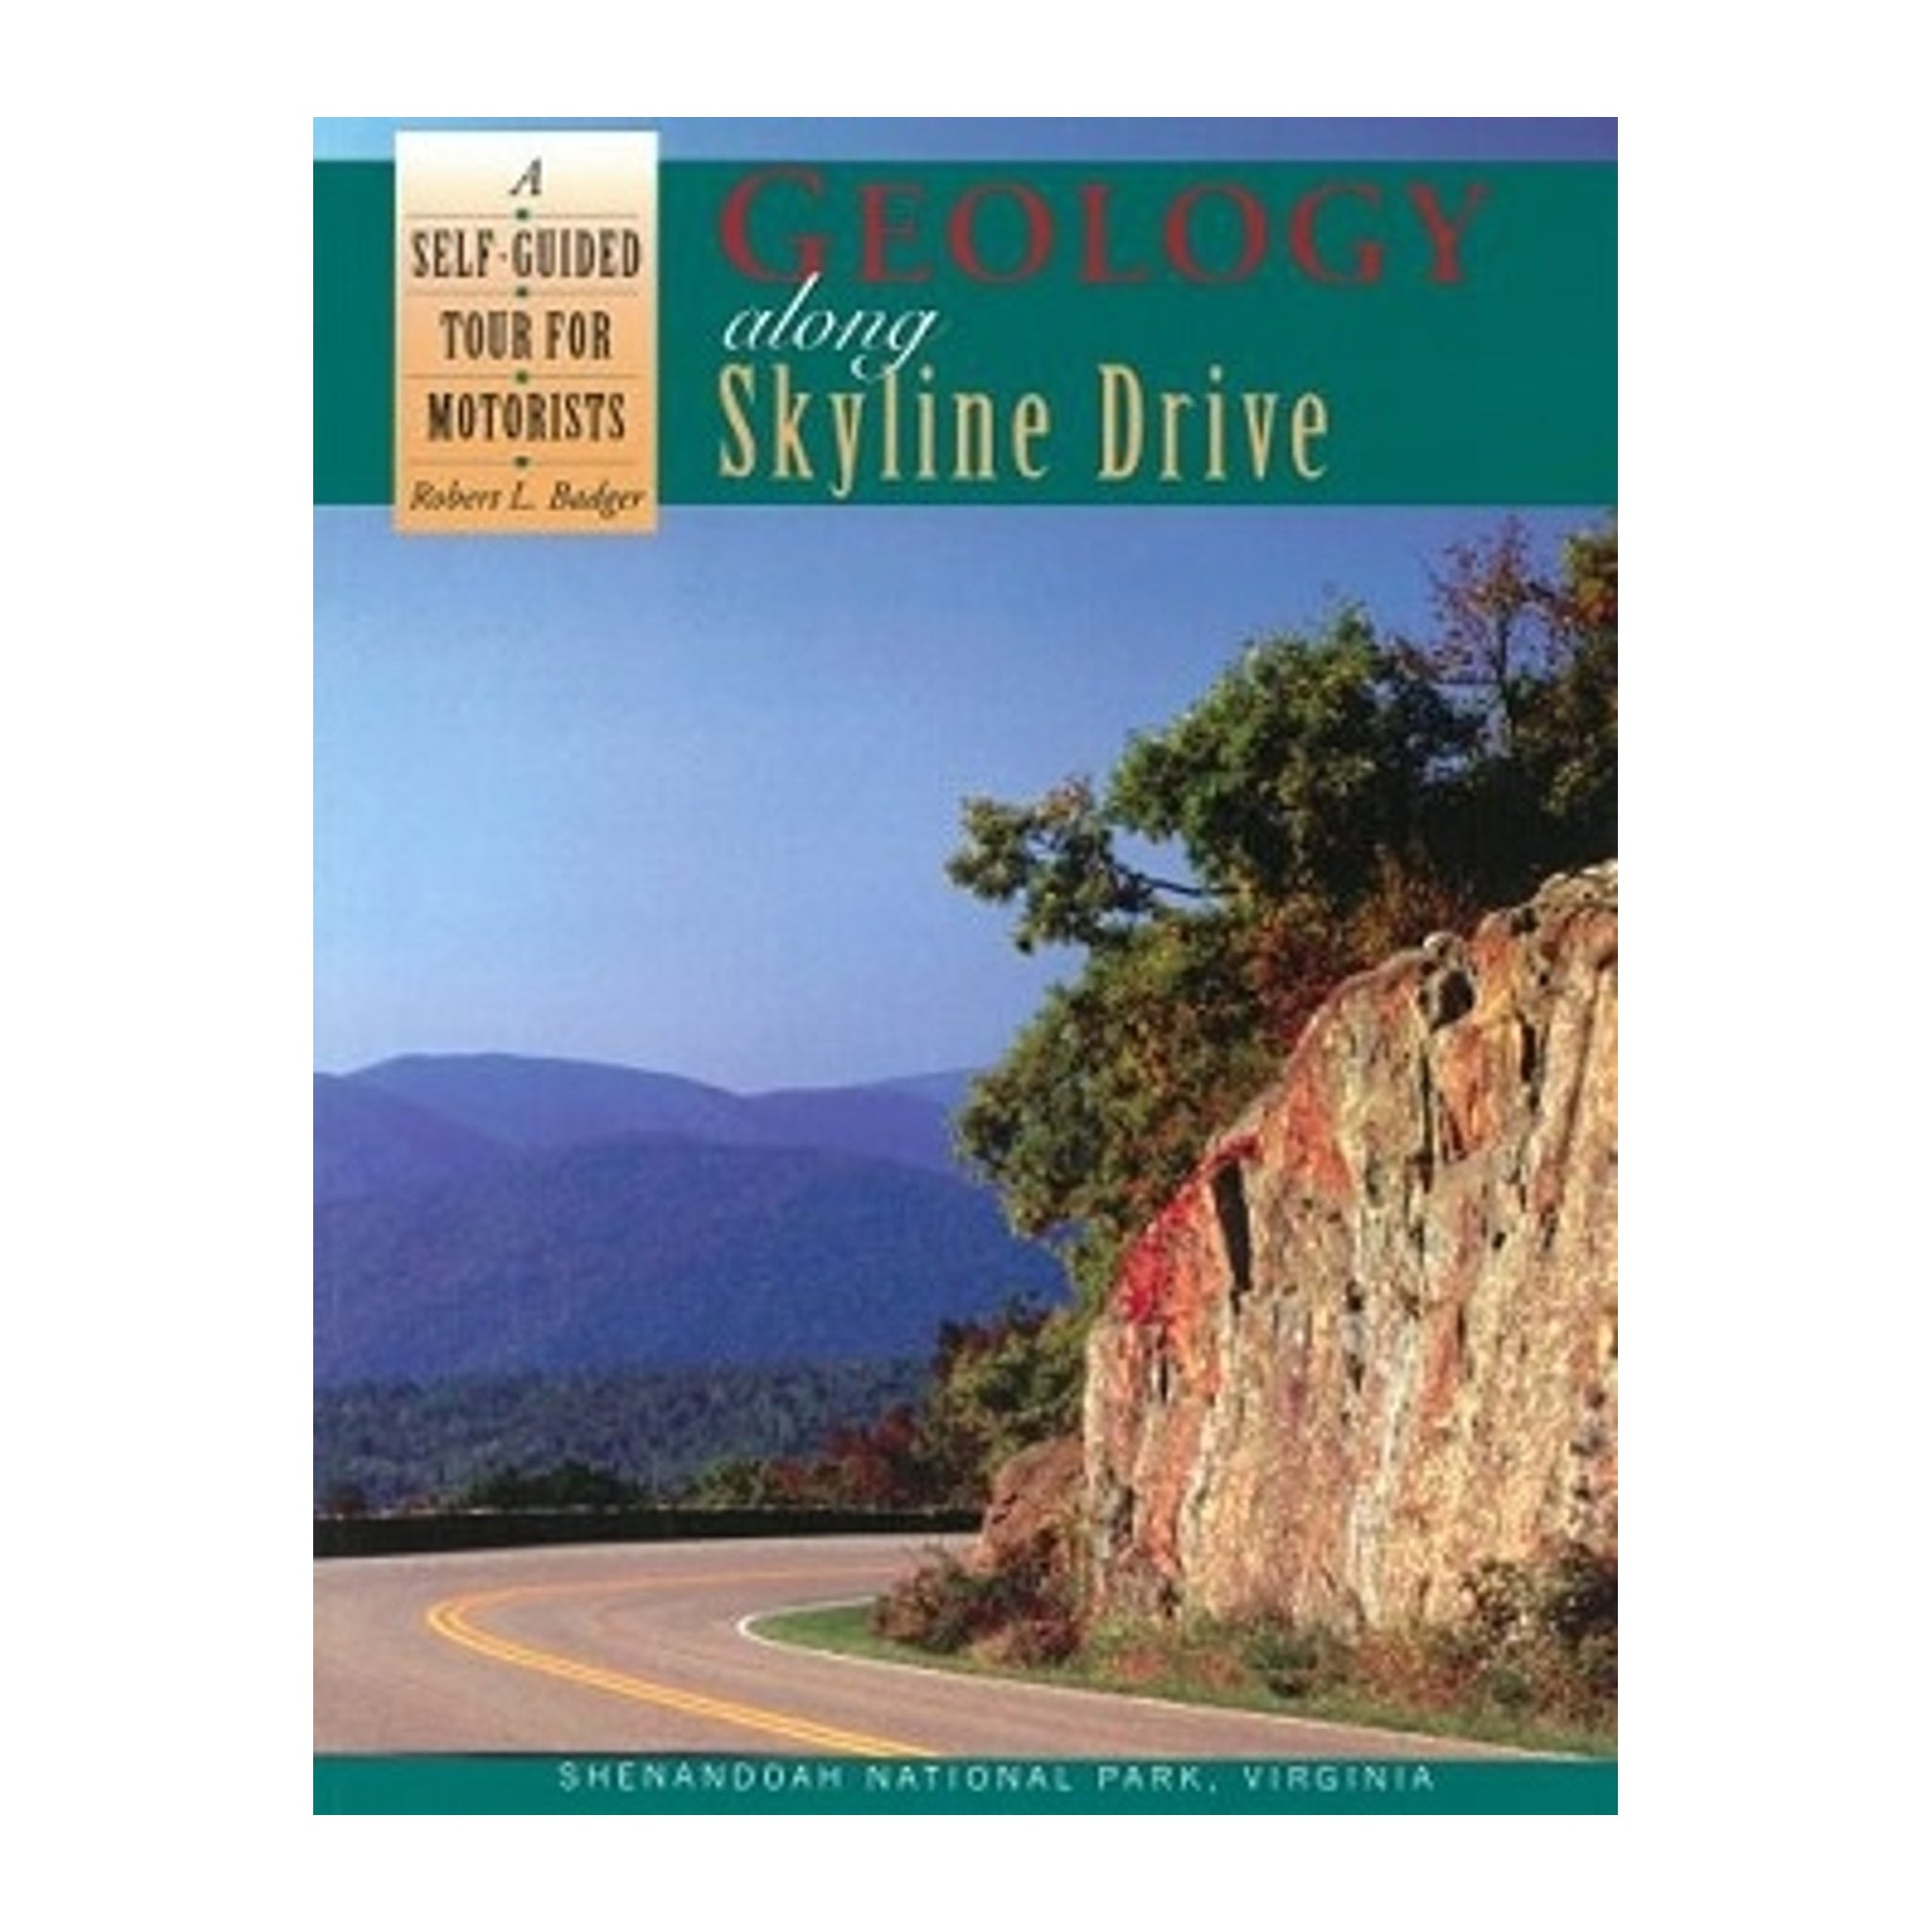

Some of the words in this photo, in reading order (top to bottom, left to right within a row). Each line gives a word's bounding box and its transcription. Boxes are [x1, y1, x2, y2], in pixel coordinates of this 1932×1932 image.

[509, 157, 543, 197] A
[718, 166, 1493, 286] GEOLOGY
[411, 228, 642, 279] SELF-GUIDED
[440, 309, 533, 360] TOUR
[544, 309, 612, 360] FOR
[723, 271, 941, 381] along
[427, 392, 625, 442] MOTORISTS
[718, 363, 1050, 498] Skyline
[1097, 363, 1329, 482] Drive
[409, 480, 501, 512] Robert
[508, 481, 536, 512] L.
[548, 480, 647, 520] Badger
[558, 1761, 843, 1792] SHENANDOAH
[865, 1764, 1074, 1792] NATIONAL
[1097, 1764, 1217, 1793] PARK,
[1242, 1764, 1436, 1792] VIRGINIA
